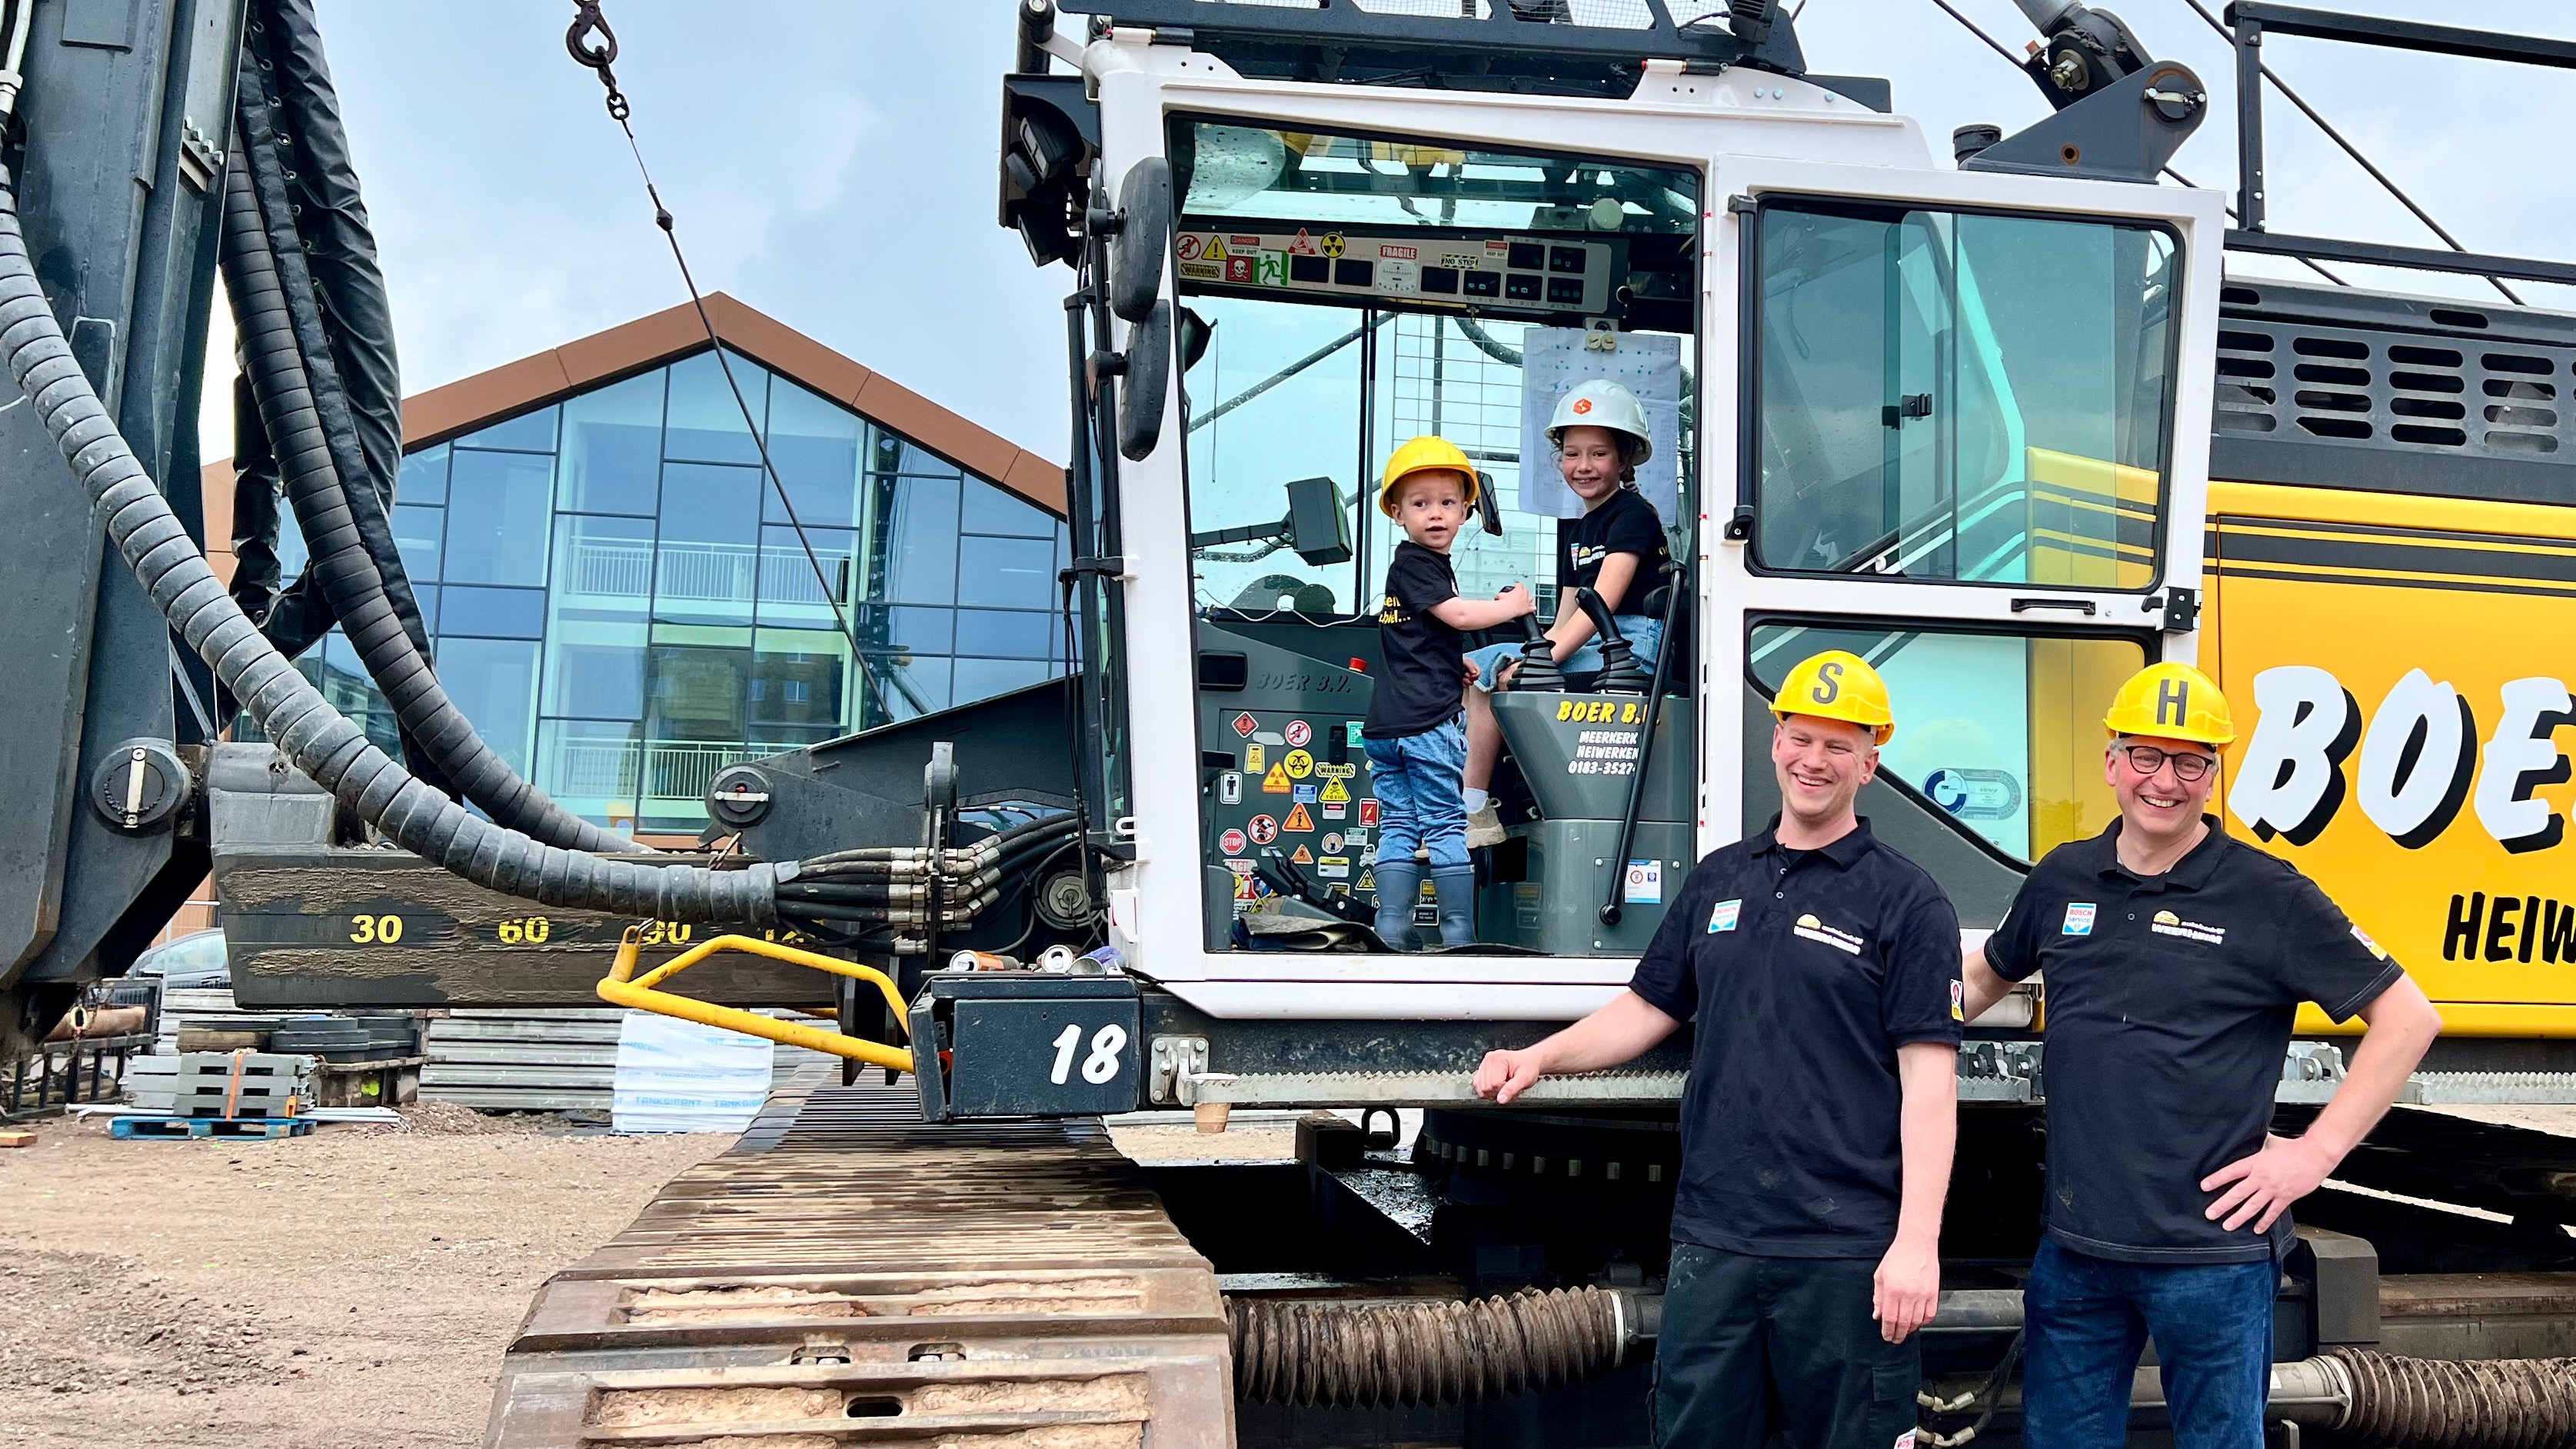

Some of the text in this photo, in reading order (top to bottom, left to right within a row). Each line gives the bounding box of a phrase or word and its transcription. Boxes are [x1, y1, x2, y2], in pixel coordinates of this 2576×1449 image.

[1233, 236, 1257, 245] DANGER
[1383, 246, 1416, 259] FRAGILE
[1185, 265, 1216, 276] WARNING
[1458, 258, 1476, 266] STEP
[1256, 673, 1352, 693] BOER B.V.
[1812, 662, 1844, 705] S
[2156, 679, 2189, 728] H
[1556, 701, 1616, 724] BOER
[1579, 730, 1639, 744] MEERKERK
[2228, 665, 2576, 854] BOE
[1320, 766, 1351, 775] WARNING
[1224, 838, 1242, 846] STOP
[349, 914, 403, 944] 30
[498, 916, 550, 944] 60
[1050, 1024, 1127, 1085] 18
[635, 1097, 702, 1107] TANKGIGANT
